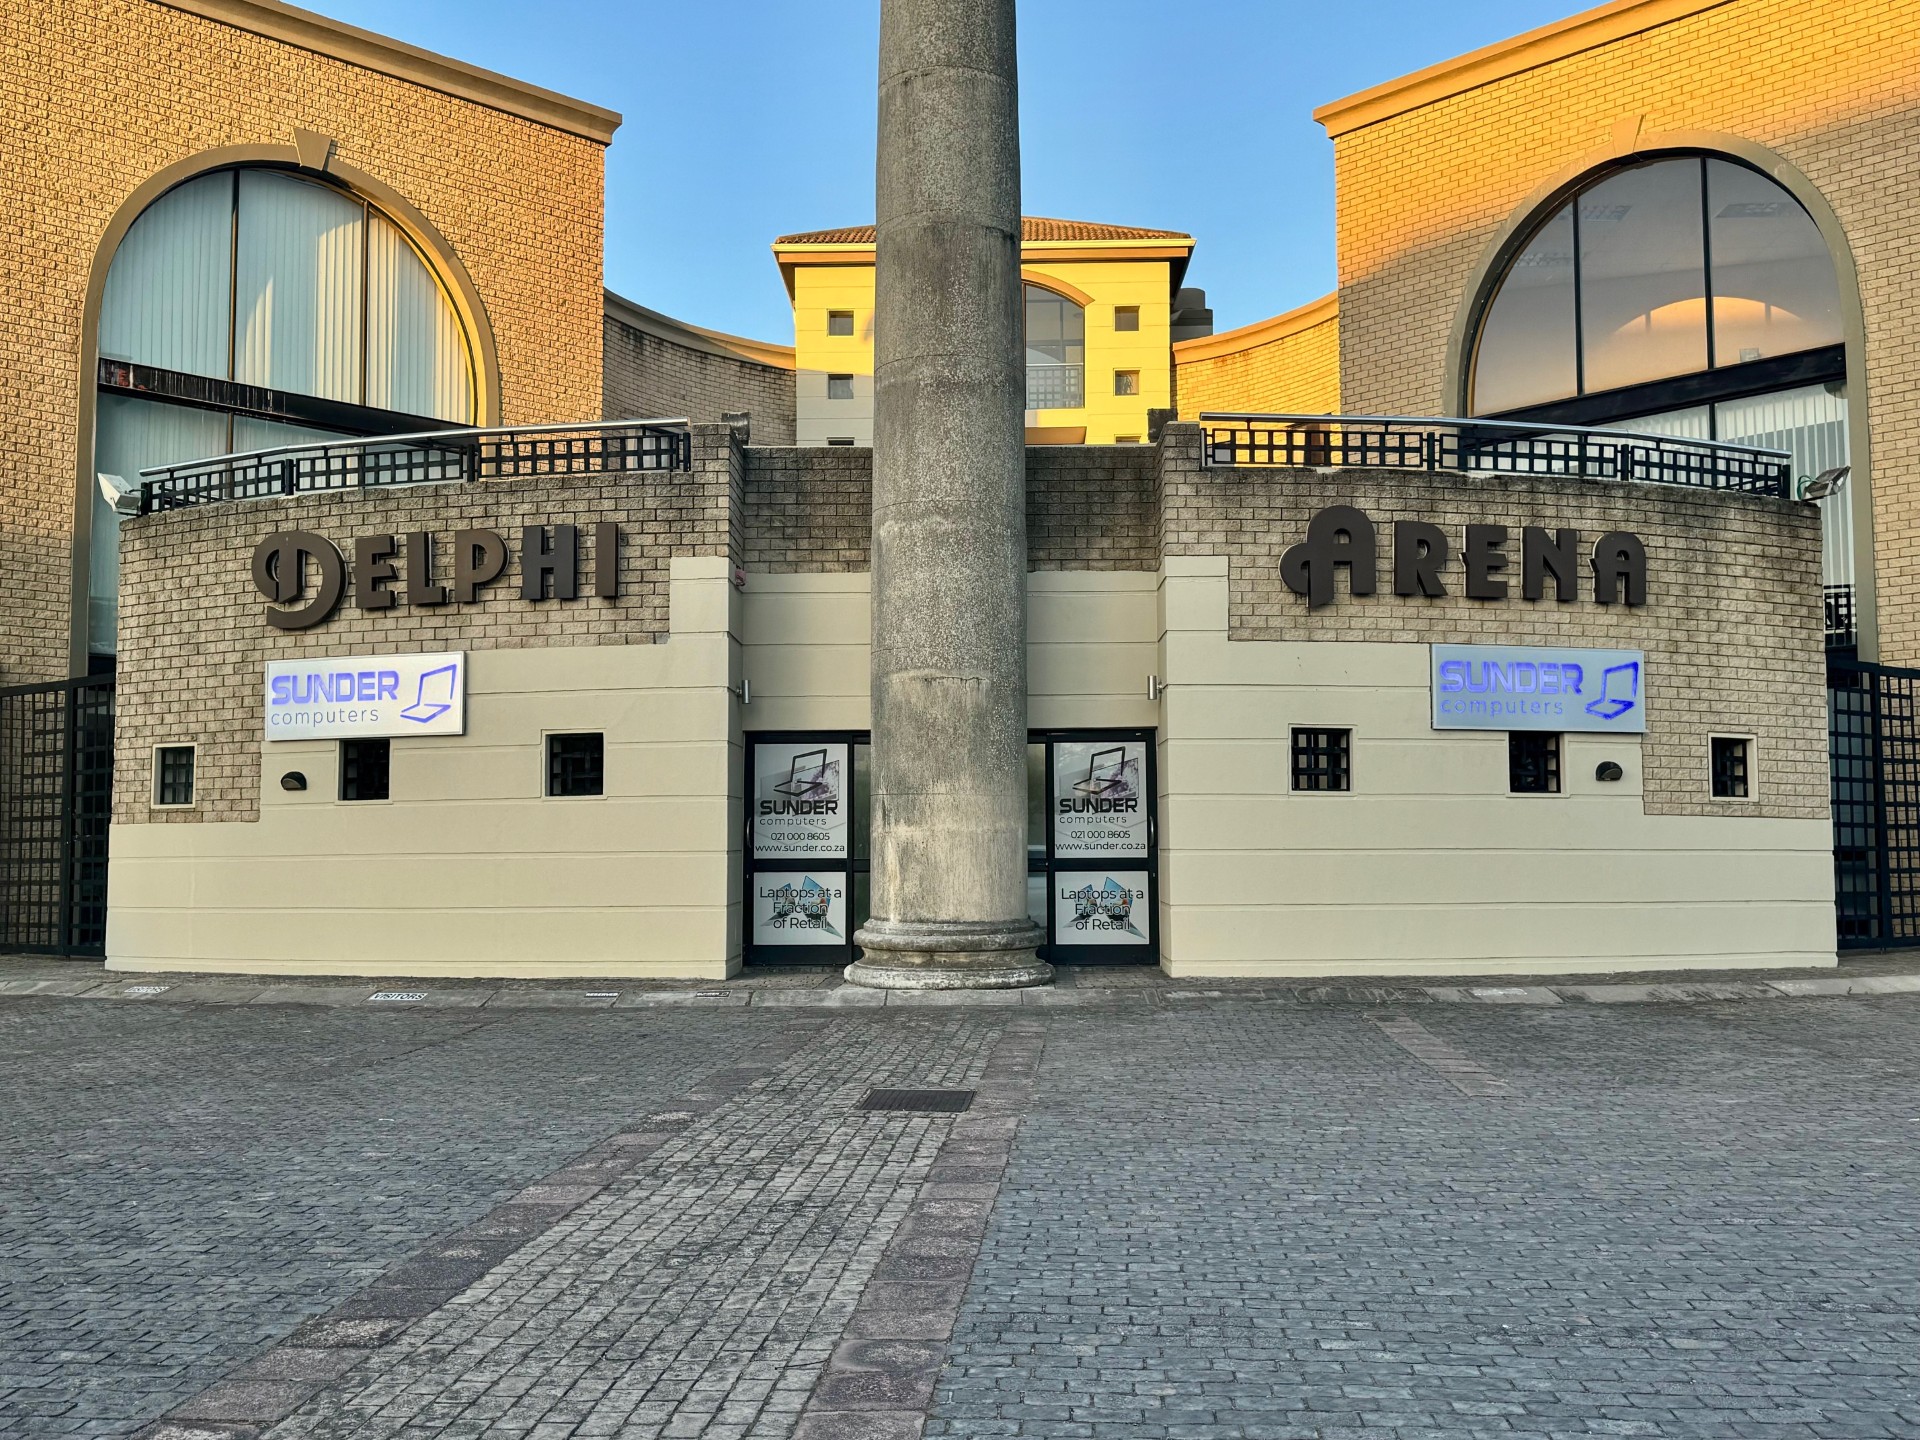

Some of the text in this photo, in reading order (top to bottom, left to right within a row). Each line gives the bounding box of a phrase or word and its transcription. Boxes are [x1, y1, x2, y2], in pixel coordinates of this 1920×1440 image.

[1278, 505, 1647, 609] ARENA
[251, 522, 619, 629] DELPHI
[1439, 660, 1584, 695] SUNDER
[271, 670, 400, 705] SUNDER
[1439, 699, 1563, 718] computers
[270, 707, 379, 727] computers
[760, 800, 838, 815] SUNDER
[1059, 798, 1137, 813] SUNDER
[759, 818, 827, 827] computers
[1059, 815, 1127, 825] computers
[770, 832, 830, 841] 021 000 8605
[1070, 830, 1131, 839] 021 000 8605
[755, 844, 845, 852] www.sunder.co.za
[1055, 842, 1146, 850] www.sunder.co.za
[759, 886, 842, 901] Laptops at a
[1061, 888, 1144, 903] Laptops at a
[773, 901, 829, 914] Fraction
[1075, 902, 1131, 915] Fraction
[773, 917, 827, 928] of Retail
[1075, 918, 1130, 930] of Retail
